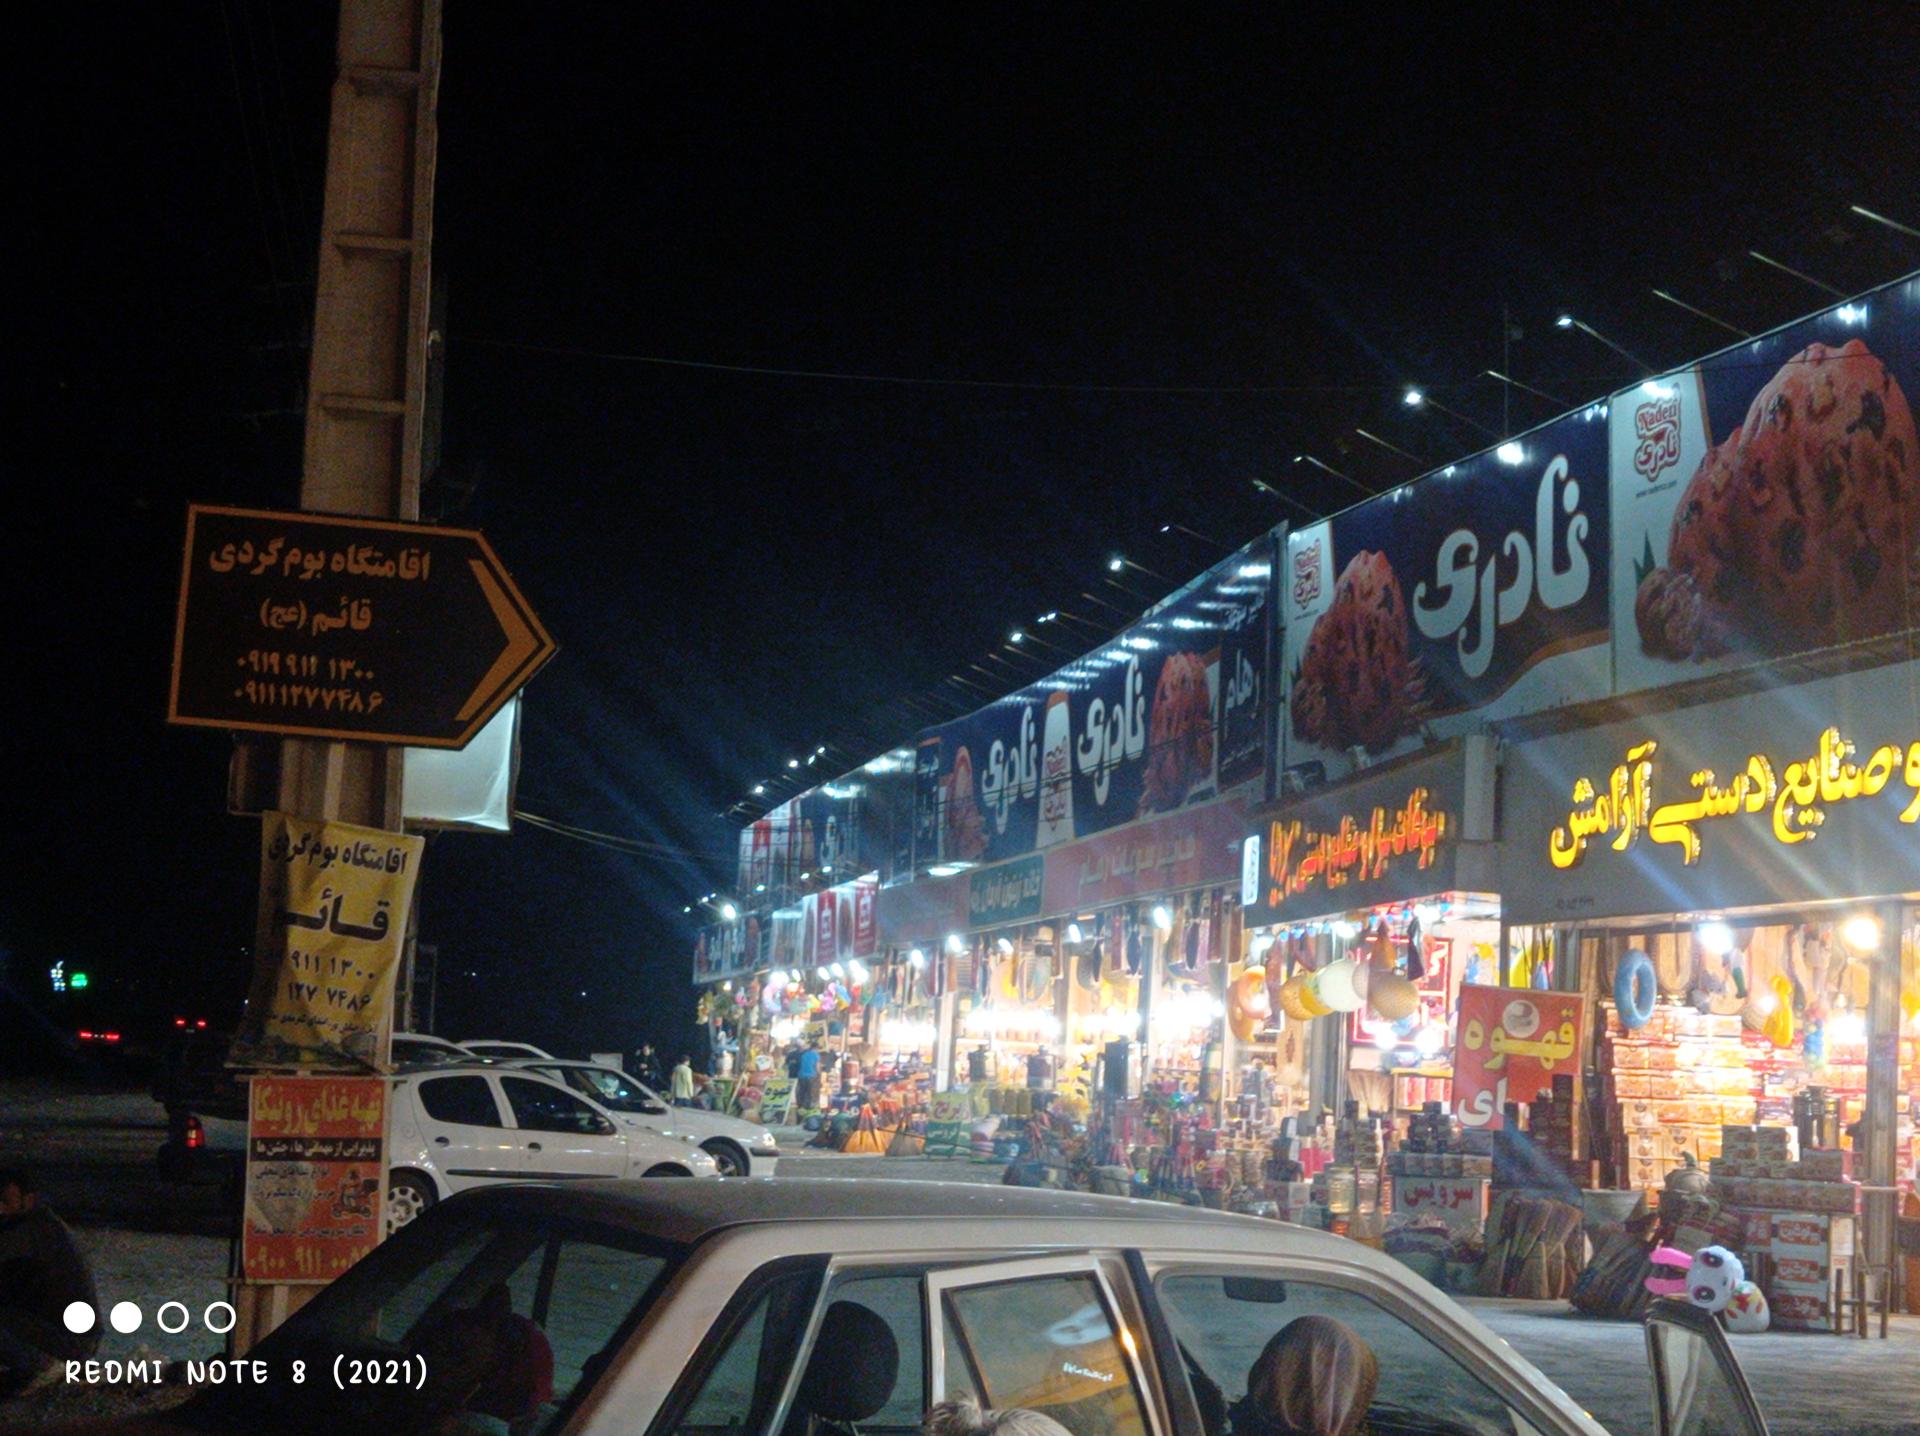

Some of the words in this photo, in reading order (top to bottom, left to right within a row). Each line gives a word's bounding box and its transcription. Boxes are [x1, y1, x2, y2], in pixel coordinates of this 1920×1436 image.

[209, 537, 286, 576] گردی
[284, 549, 325, 580] بوم
[331, 544, 431, 581] اقامتگاه
[1413, 454, 1590, 678] نادری
[260, 599, 307, 628] (عج)
[312, 596, 373, 636] قائم
[1077, 655, 1145, 805] نادری
[981, 705, 1037, 835] نادری
[1773, 727, 1900, 843] صنایع
[1550, 740, 1656, 868] آرامش
[1650, 755, 1776, 866] دستی
[308, 841, 339, 869] بوم
[342, 841, 408, 875] اقامتگاه
[280, 888, 389, 941] قائ
[1464, 1008, 1575, 1070] قهوه
